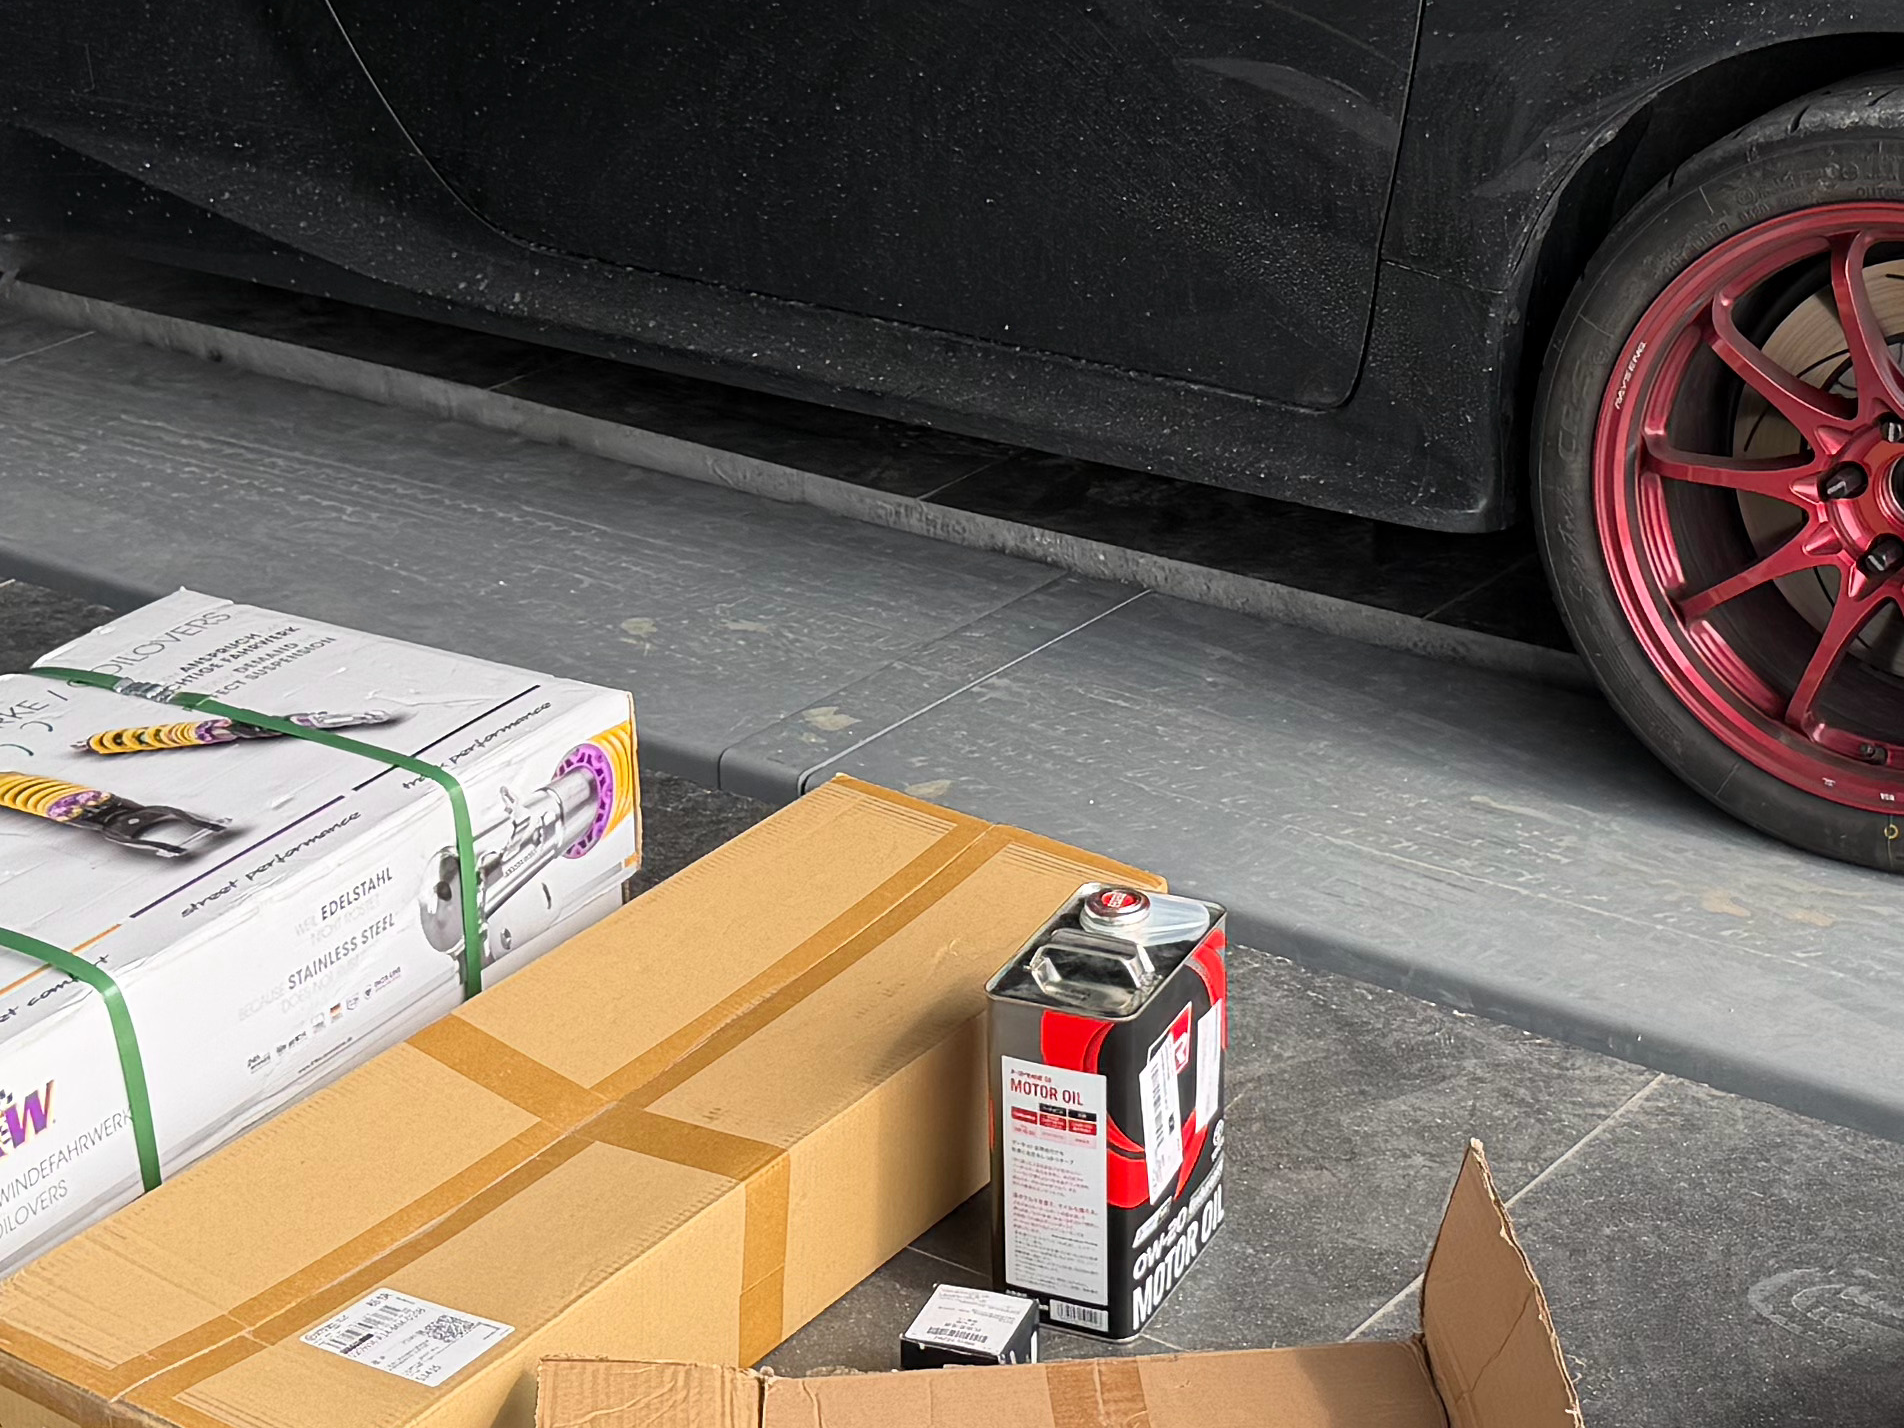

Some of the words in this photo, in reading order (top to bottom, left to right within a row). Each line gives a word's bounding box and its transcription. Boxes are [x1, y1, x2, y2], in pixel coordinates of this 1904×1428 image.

[179, 632, 264, 673] ANSPRUCH
[224, 626, 300, 663] FAHRWERK
[233, 642, 299, 673] DEMAND
[449, 701, 552, 765] performance
[182, 879, 238, 918] street
[245, 811, 362, 882] performance
[321, 867, 393, 922] EDELSTAHL
[287, 935, 358, 991] STAINLESS
[361, 912, 395, 945] STEEL
[1011, 1077, 1058, 1102] MOTOR
[1062, 1089, 1084, 1106] OIL
[1133, 1220, 1199, 1330] MOTOR
[1200, 1183, 1225, 1244] OIL
